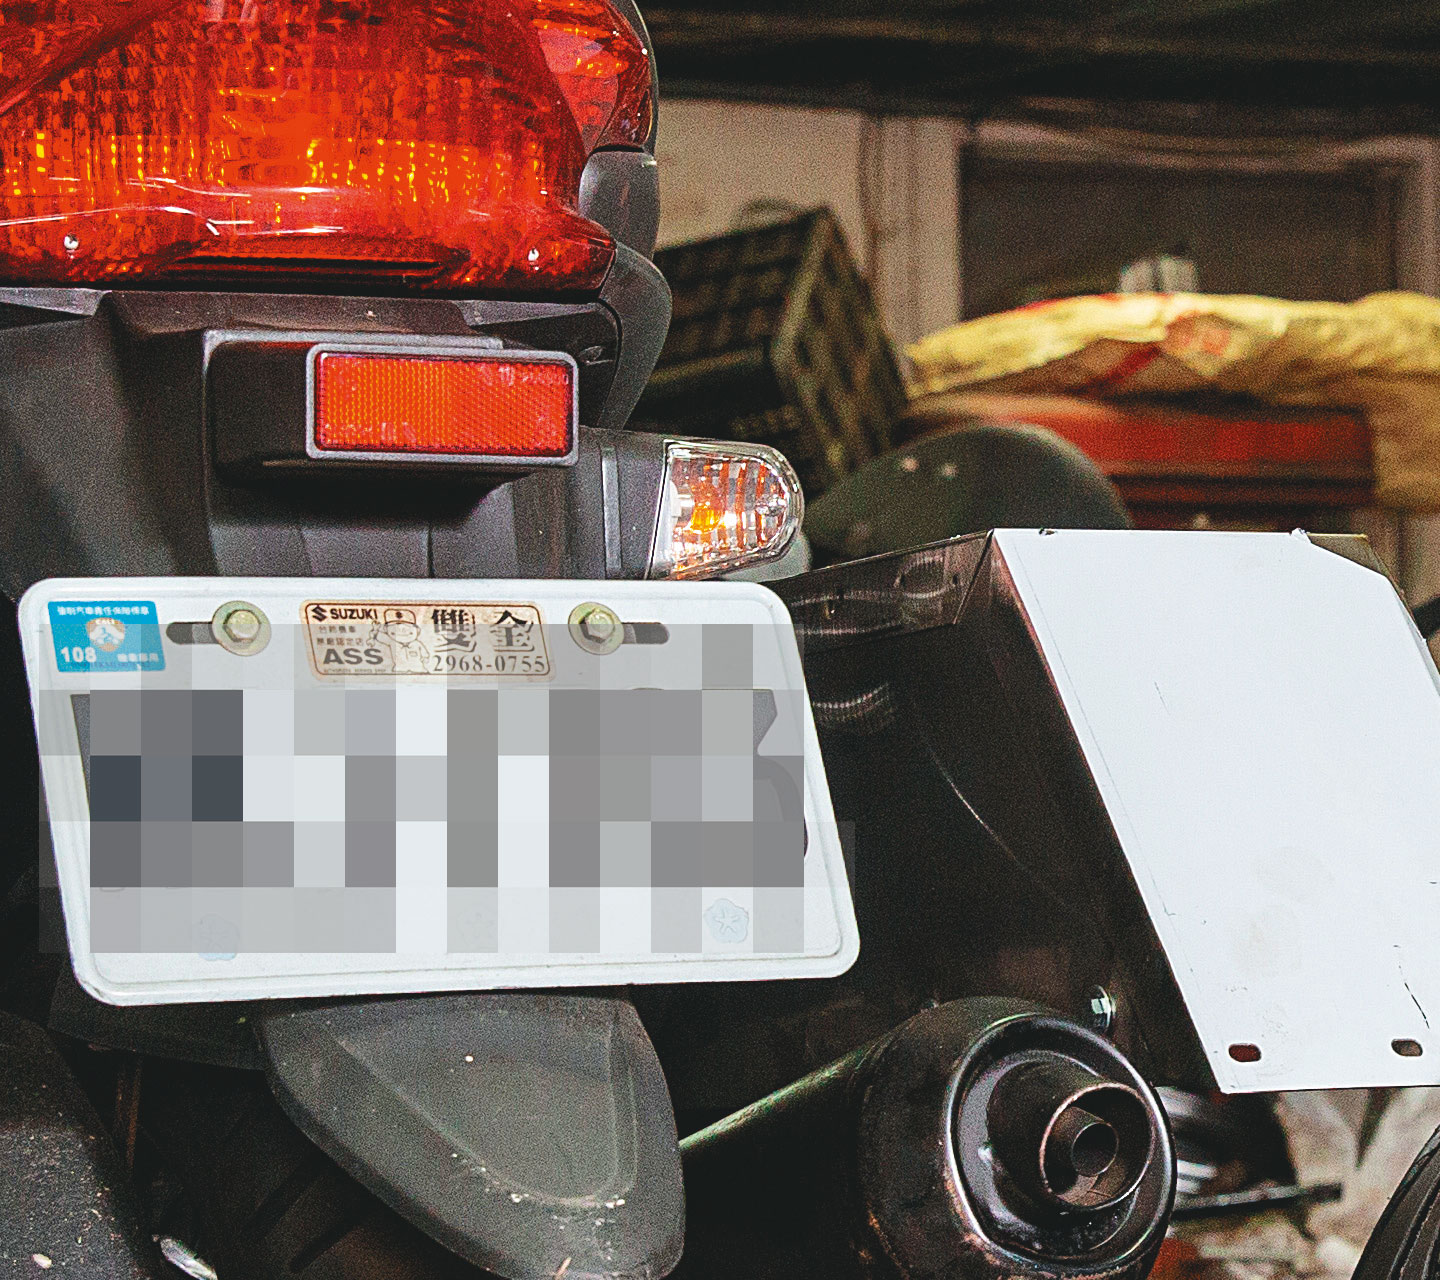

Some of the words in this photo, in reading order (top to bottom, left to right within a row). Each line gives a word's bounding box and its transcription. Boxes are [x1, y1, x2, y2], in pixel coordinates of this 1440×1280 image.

[329, 608, 378, 620] SUZUKI
[60, 646, 97, 664] 108
[323, 648, 384, 665] ASS
[433, 654, 546, 673] 2968-0755
